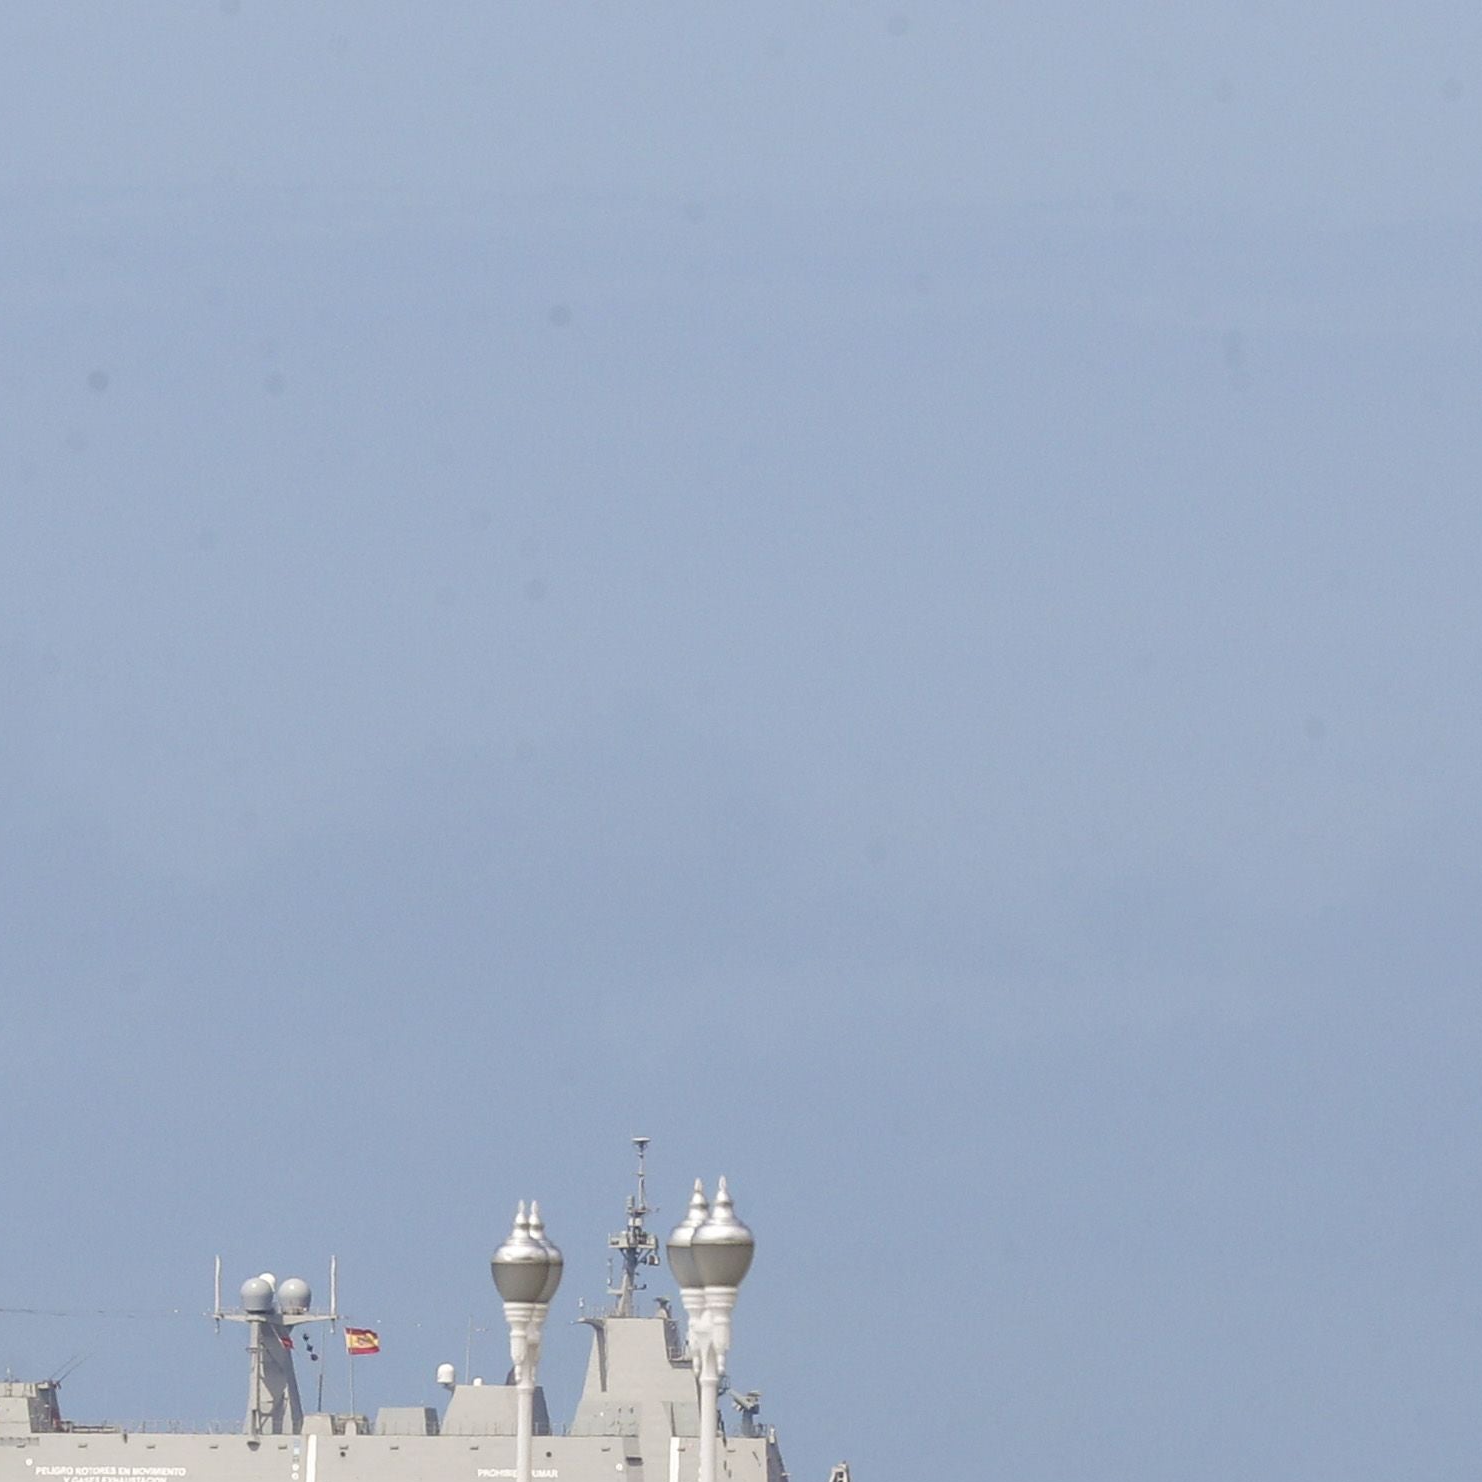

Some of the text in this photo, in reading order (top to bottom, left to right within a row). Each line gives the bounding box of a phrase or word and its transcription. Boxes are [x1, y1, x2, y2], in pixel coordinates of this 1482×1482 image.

[35, 1466, 187, 1477] PELIGRO ROTORES EN MOVIMIENTO
[531, 1469, 559, 1479] UMAR
